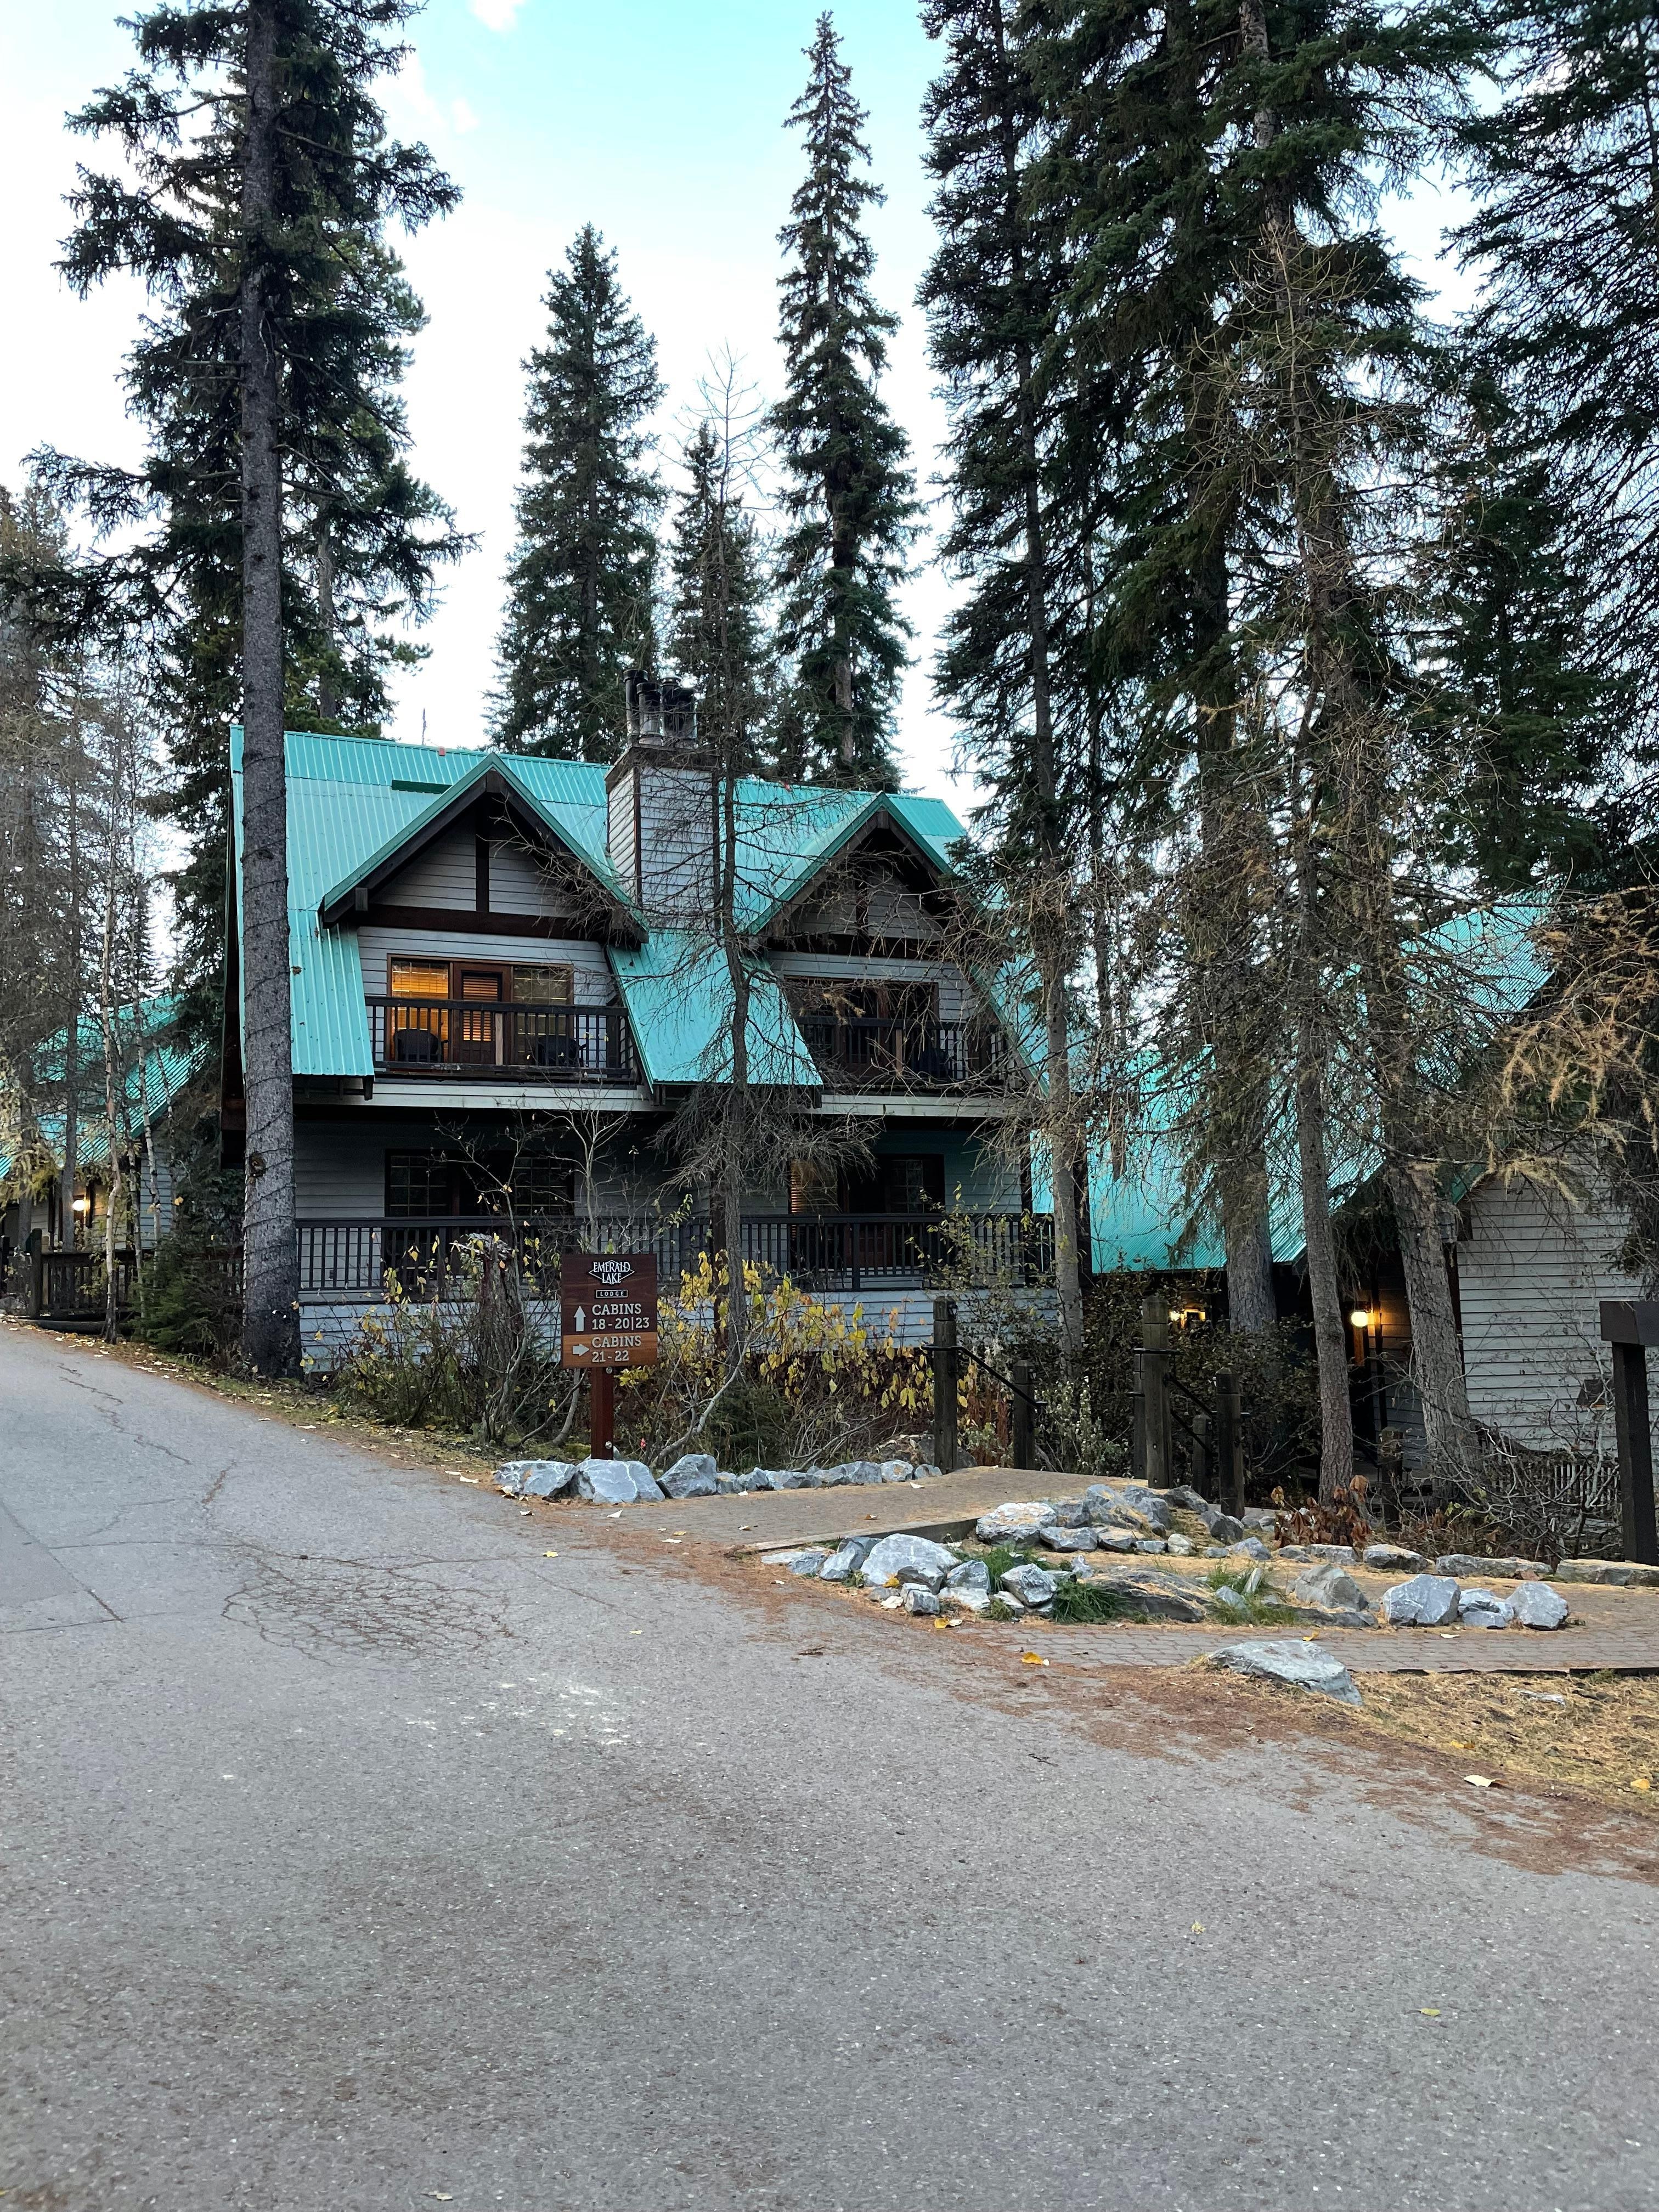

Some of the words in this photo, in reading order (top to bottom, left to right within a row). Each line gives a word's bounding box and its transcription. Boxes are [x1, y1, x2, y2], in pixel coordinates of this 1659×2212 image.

[594, 1262, 630, 1273] EMERALD
[602, 1273, 622, 1284] LAKE
[592, 1304, 641, 1316] CABINS
[592, 1335, 642, 1348] CABINS
